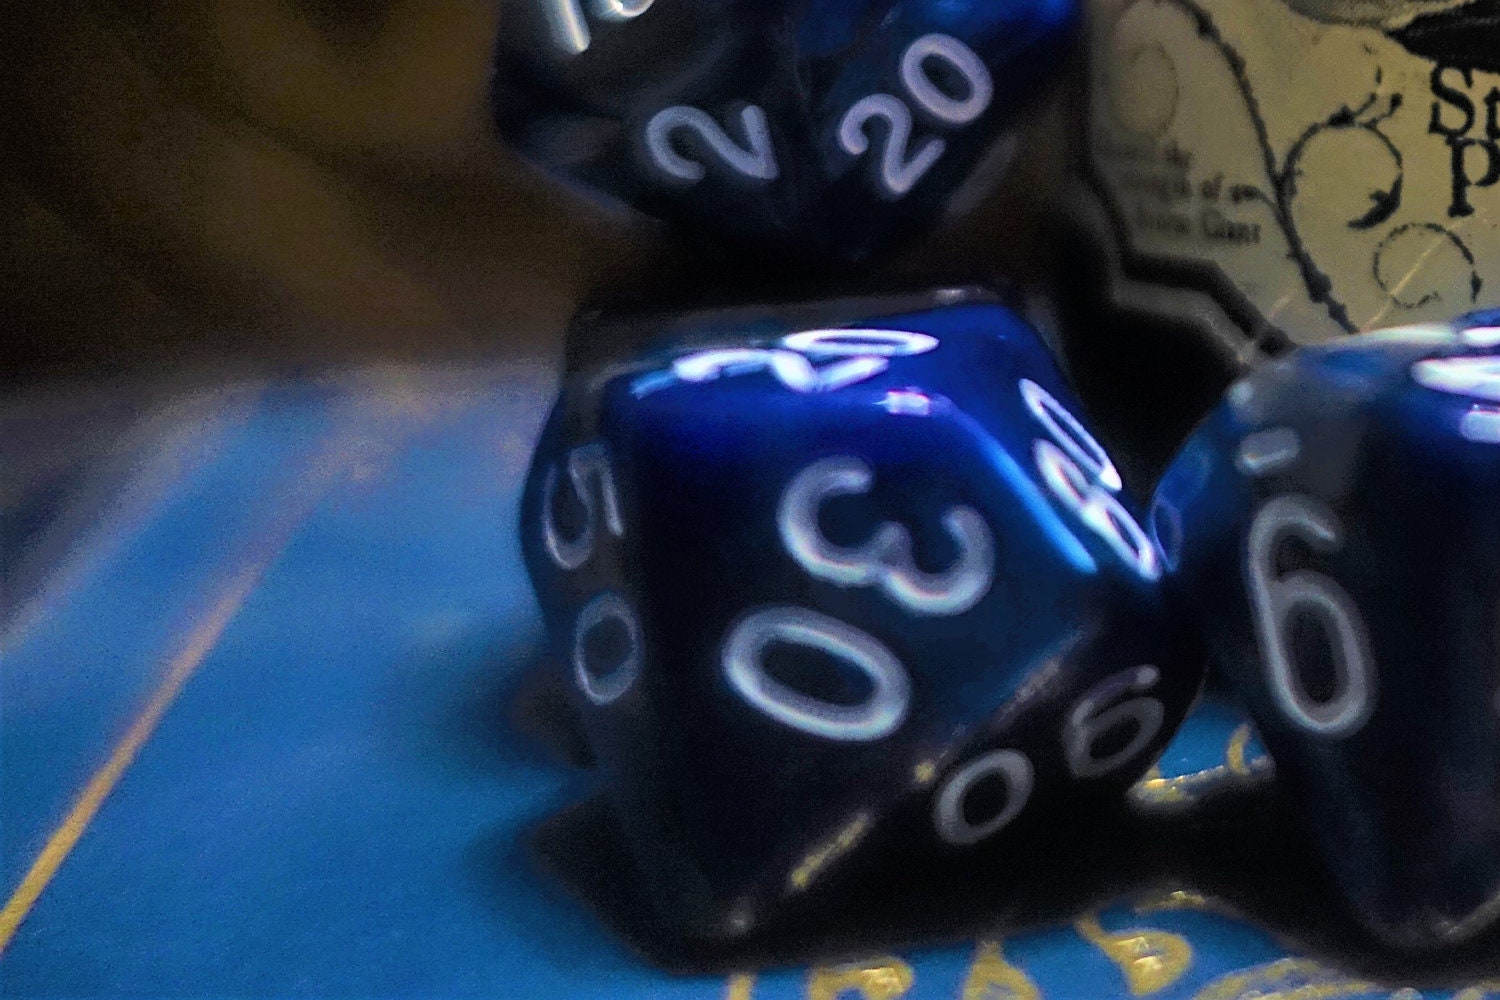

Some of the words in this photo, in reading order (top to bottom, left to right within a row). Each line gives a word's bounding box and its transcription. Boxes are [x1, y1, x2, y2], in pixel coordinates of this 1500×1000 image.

[645, 105, 779, 181] 2
[840, 32, 994, 195] 20
[722, 455, 996, 743] 30
